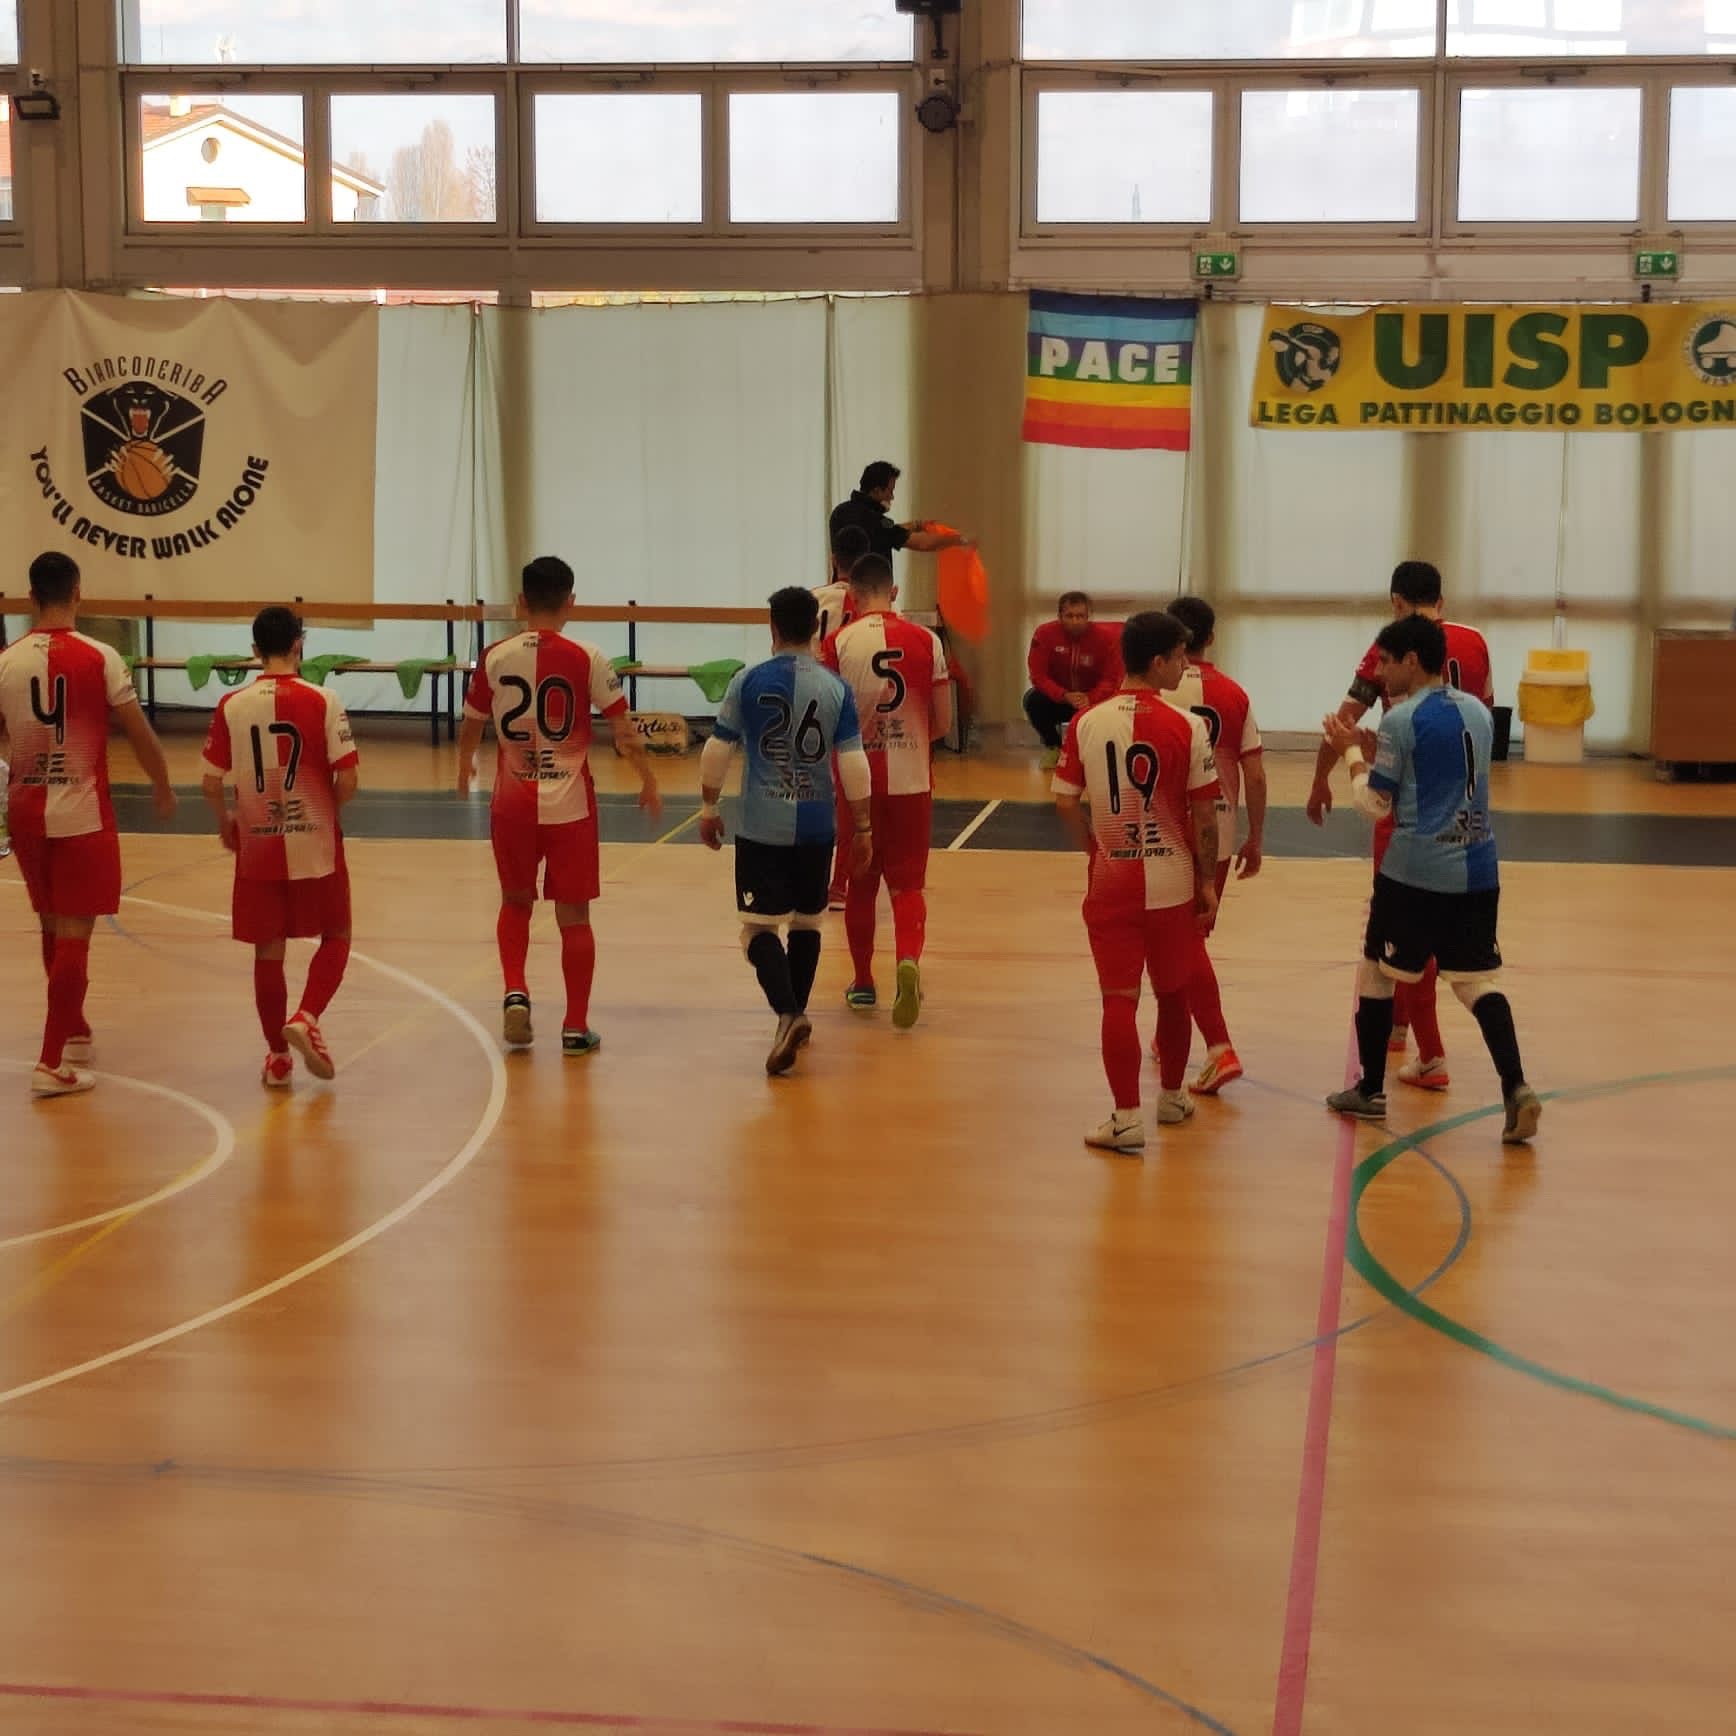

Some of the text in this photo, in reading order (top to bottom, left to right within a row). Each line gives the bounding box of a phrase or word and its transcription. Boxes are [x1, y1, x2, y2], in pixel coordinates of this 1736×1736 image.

[1039, 335, 1181, 383] PACE
[1374, 312, 1649, 391] UISP
[1257, 401, 1339, 425] LEGA
[1359, 401, 1582, 426] PATTINAGGIO
[71, 516, 147, 560] NEVER
[151, 519, 220, 560] WALK
[215, 455, 269, 531] ALONE
[30, 674, 67, 746] 4
[498, 673, 576, 743] 20
[871, 648, 906, 714] 5
[250, 721, 303, 794] 17
[756, 693, 827, 765] 26
[1462, 728, 1478, 801] 1
[1104, 739, 1160, 816] 19
